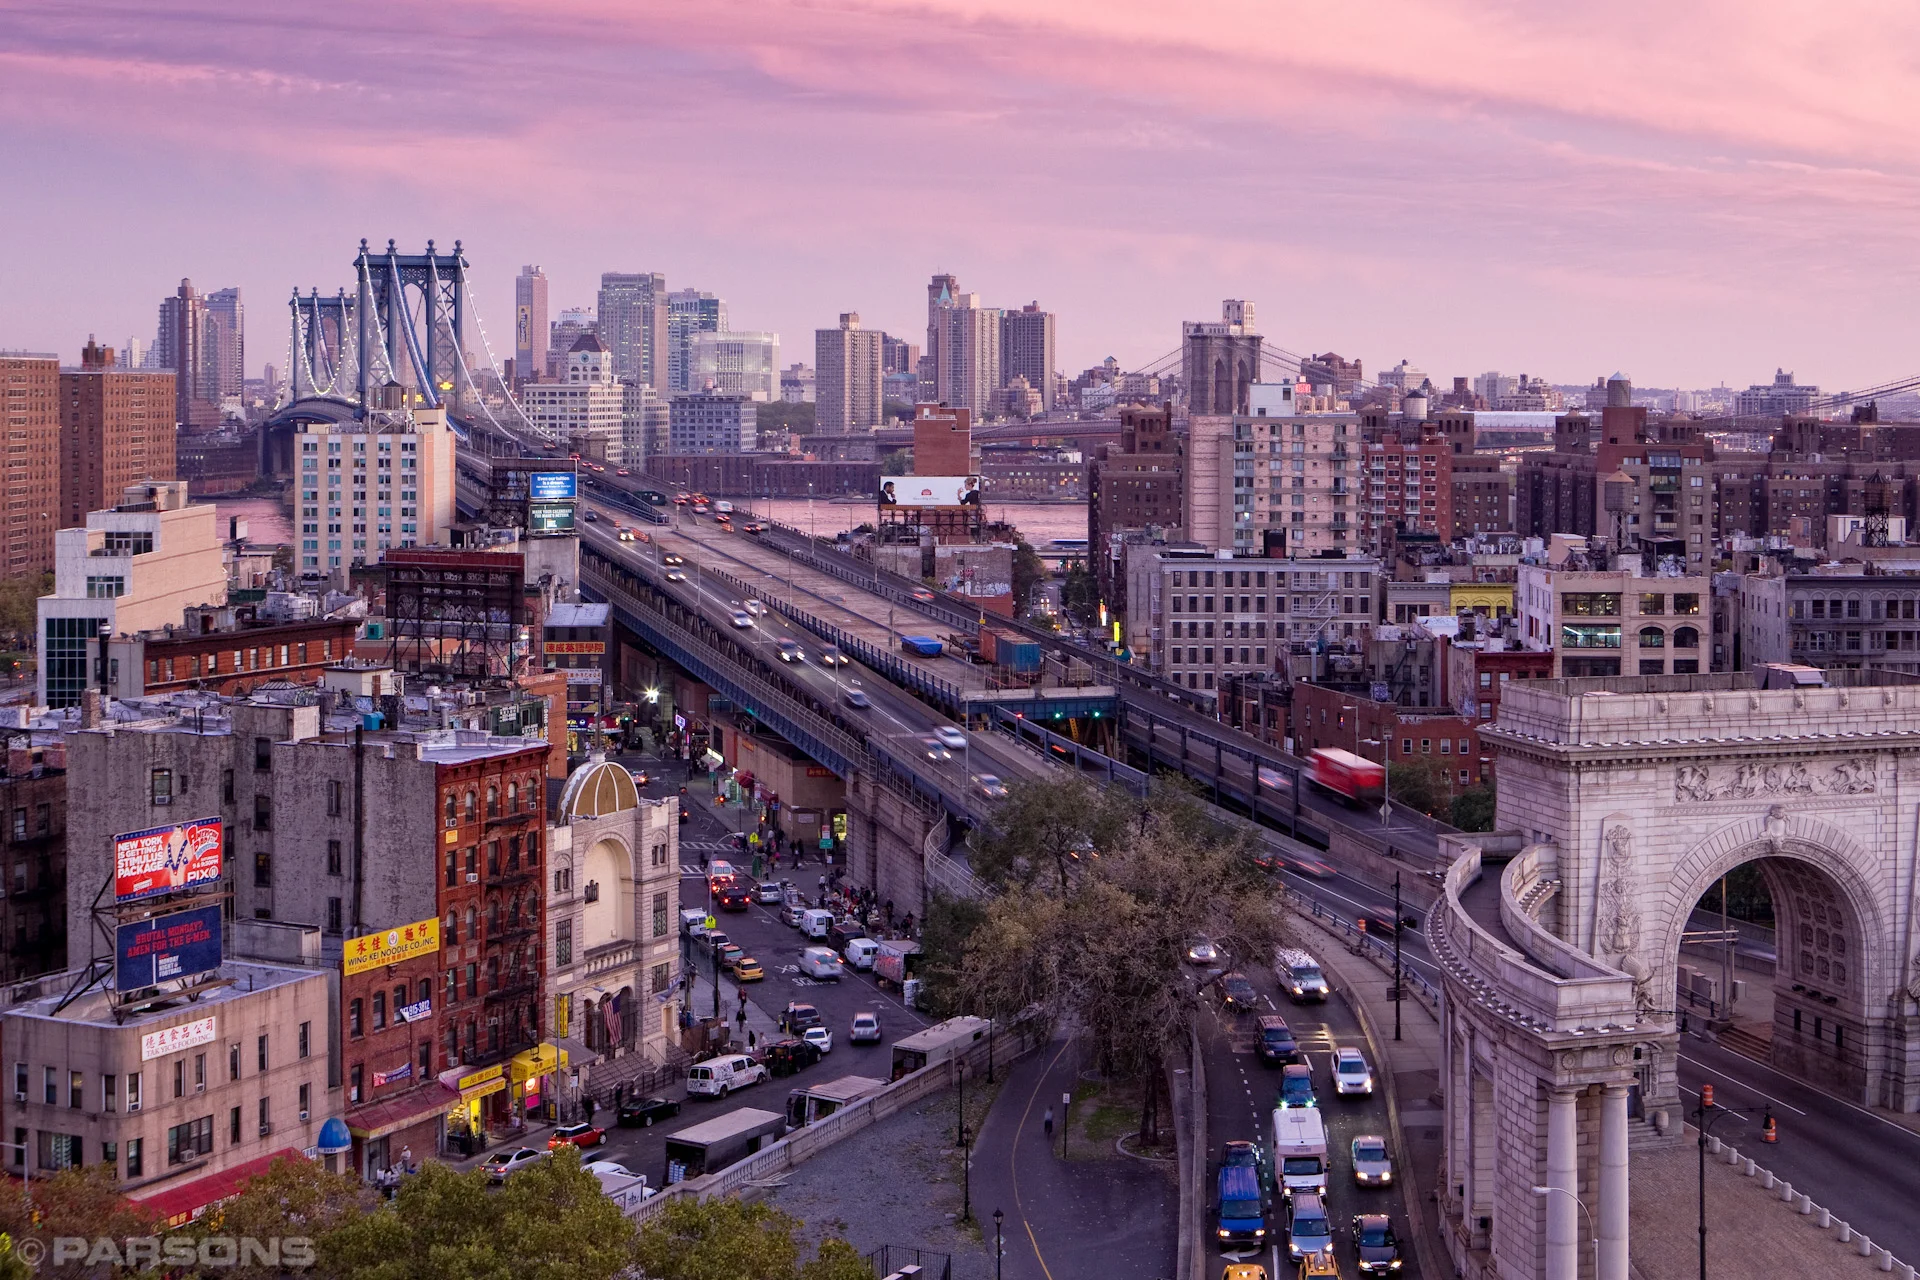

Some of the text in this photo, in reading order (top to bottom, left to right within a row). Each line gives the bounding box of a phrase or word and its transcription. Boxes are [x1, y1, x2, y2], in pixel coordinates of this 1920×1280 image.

[118, 836, 163, 852] NEW YORK
[118, 851, 125, 859] IS
[126, 846, 157, 858] GETTING
[118, 852, 164, 869] STIMULUS
[118, 862, 164, 878] PACKAGE
[188, 870, 209, 882] PIX
[136, 920, 203, 944] BRUTAL MONDAY?
[127, 943, 150, 957] AMEN
[152, 940, 167, 951] FOR
[170, 935, 184, 948] THE
[356, 936, 382, 955] 永佳
[348, 956, 368, 966] WING
[369, 953, 380, 961] KEI
[380, 945, 408, 957] NOODLE
[146, 1048, 160, 1057] TAK
[161, 1043, 178, 1052] YICK
[178, 1038, 198, 1048] FOOD
